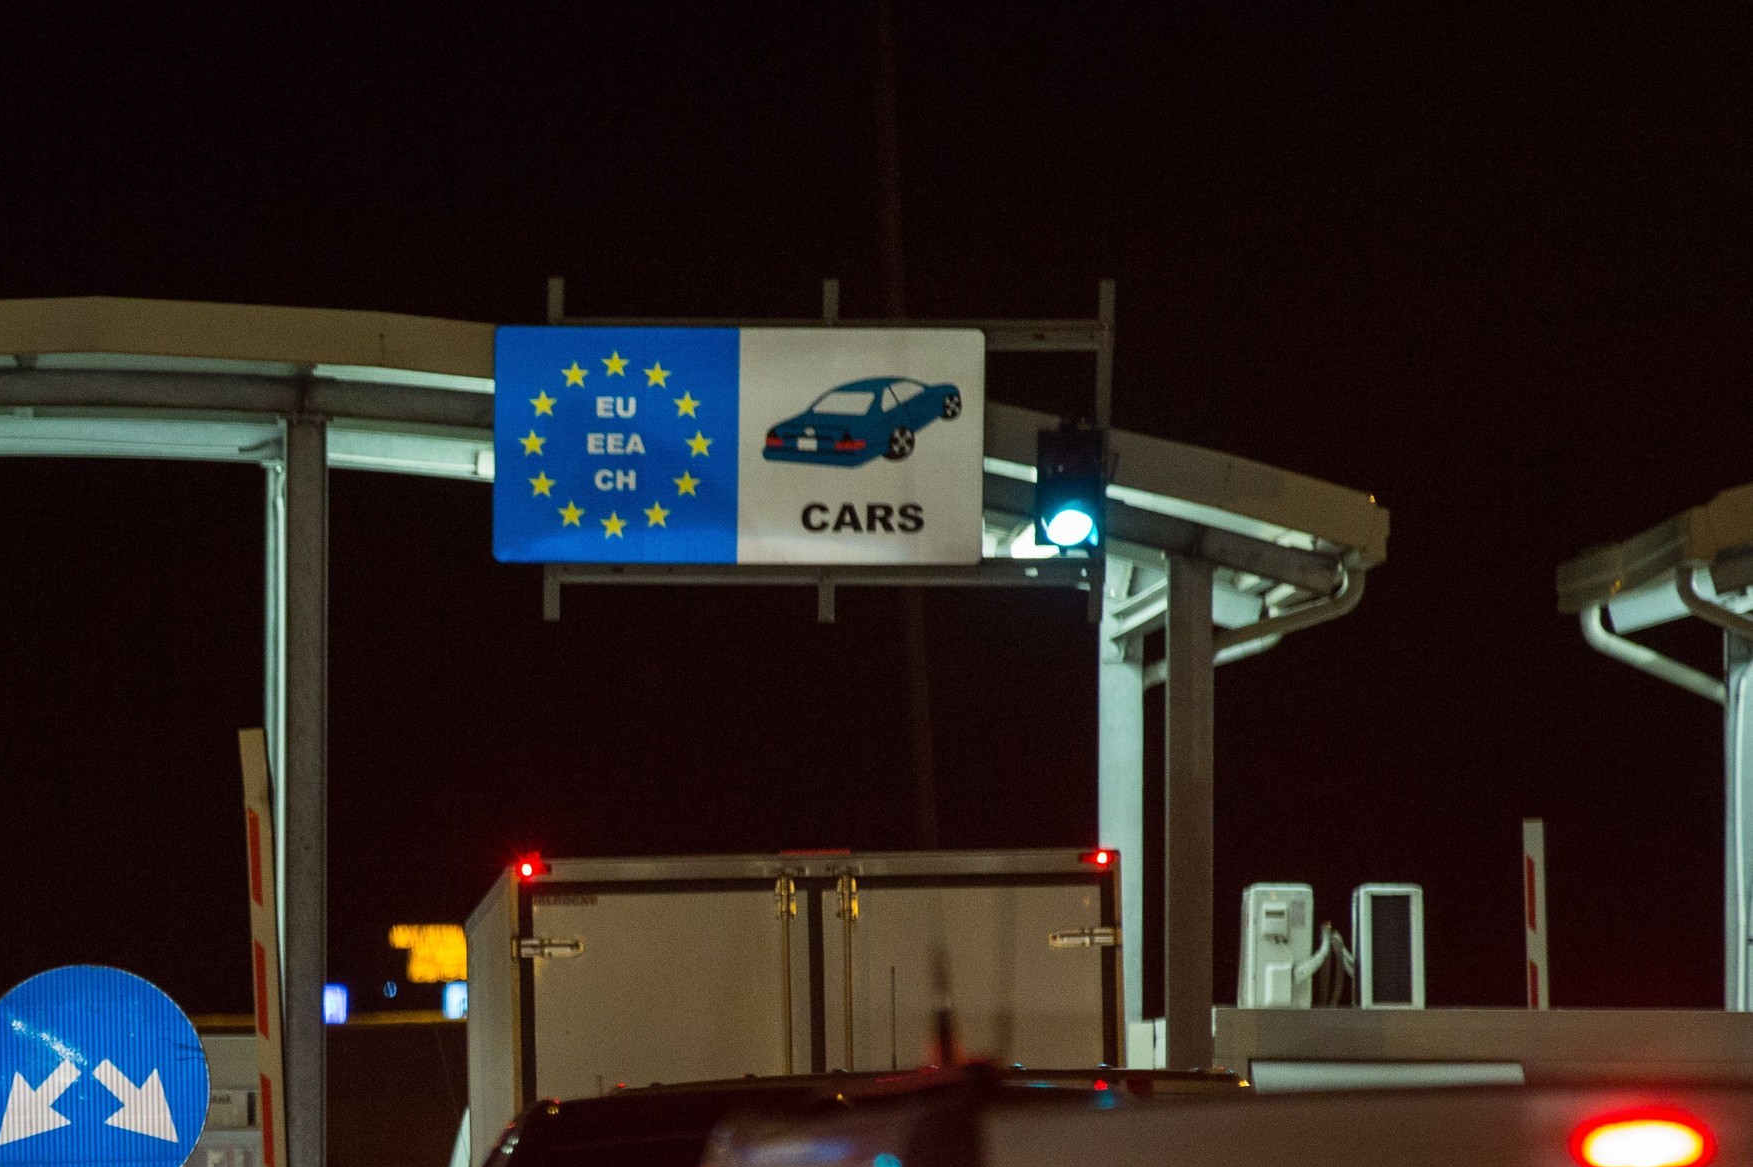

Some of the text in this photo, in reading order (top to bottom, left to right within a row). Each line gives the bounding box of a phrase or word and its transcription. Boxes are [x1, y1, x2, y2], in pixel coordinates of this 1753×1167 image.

[596, 396, 637, 419] EU
[586, 432, 646, 456] EEA
[594, 468, 637, 492] CH
[801, 502, 925, 534] CARS
